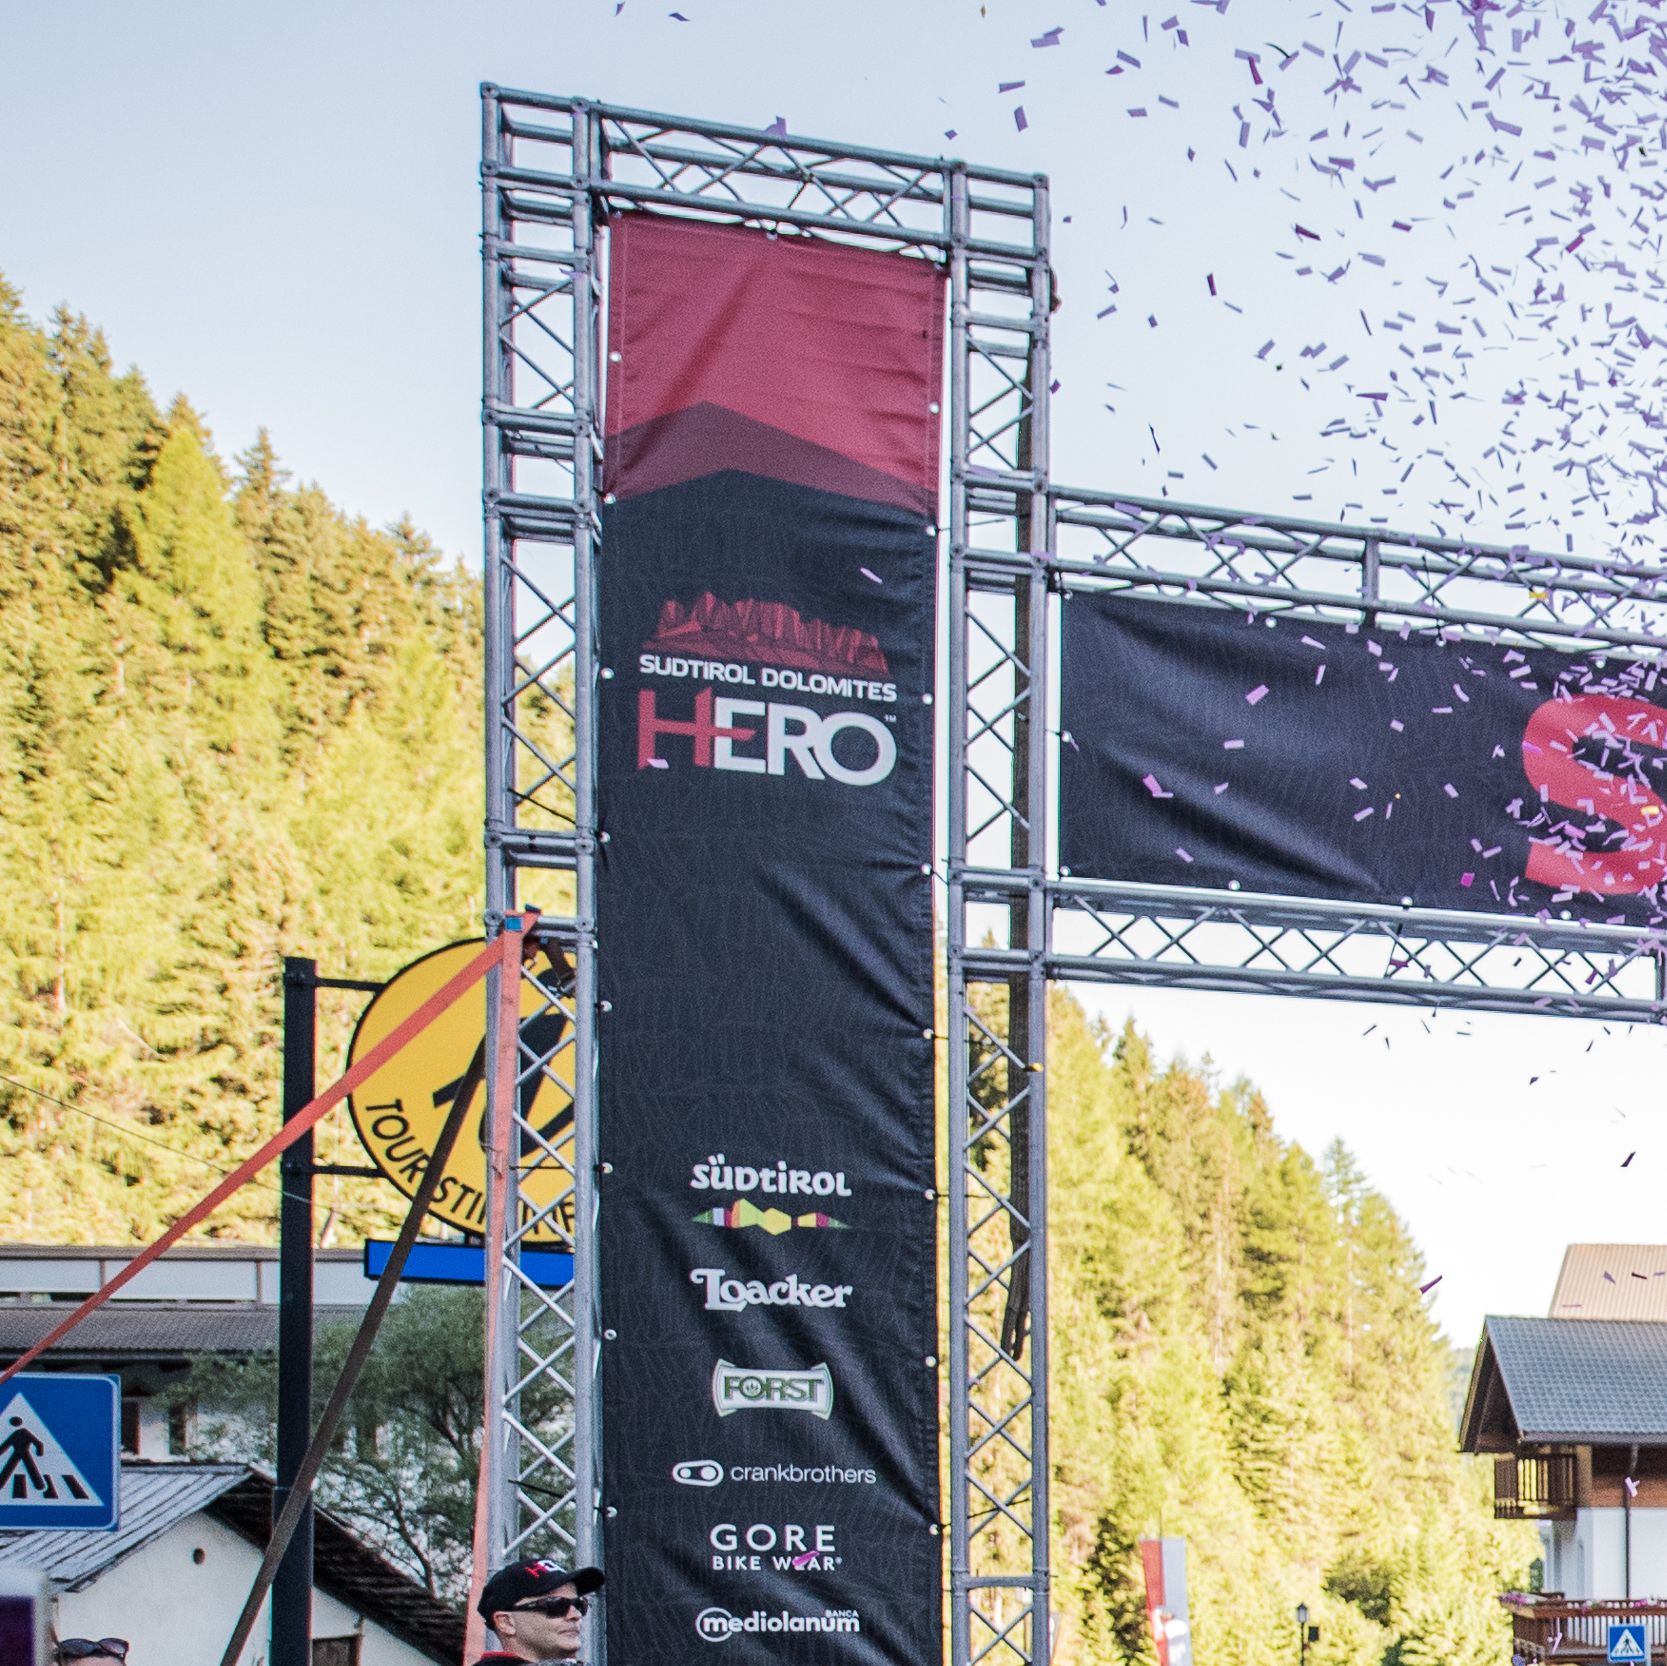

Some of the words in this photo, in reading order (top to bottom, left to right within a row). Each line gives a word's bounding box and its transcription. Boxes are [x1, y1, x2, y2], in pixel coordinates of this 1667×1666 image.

[761, 667, 897, 703] DOLOMITES
[638, 687, 898, 787] HERO
[690, 1268, 854, 1311] Loacker
[723, 1374, 823, 1402] FORST
[730, 1463, 877, 1485] crankbrothers
[710, 1524, 836, 1553] GORE
[713, 1555, 762, 1571] BIKE
[702, 1611, 861, 1634] mediolanum
